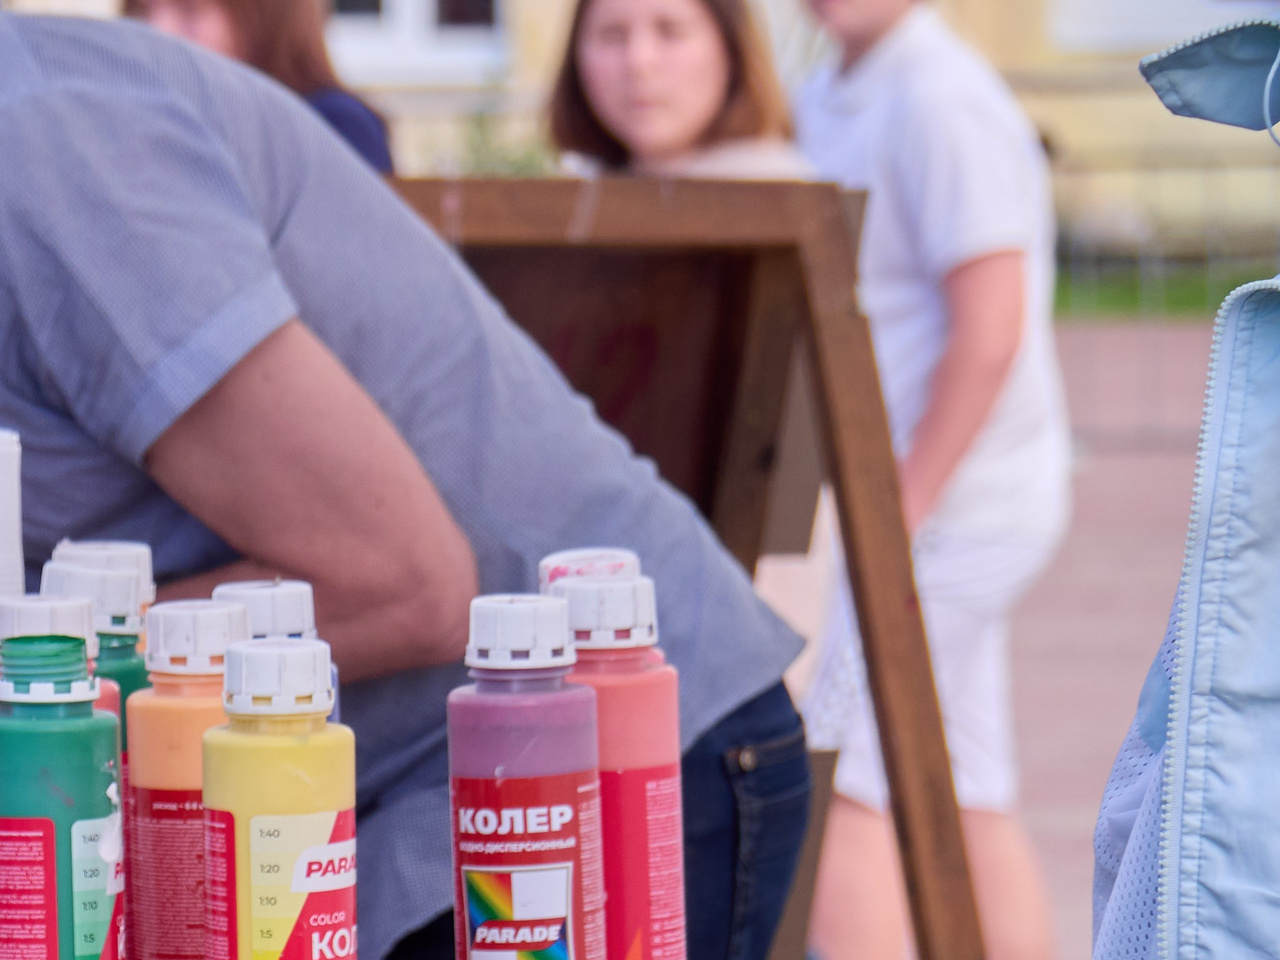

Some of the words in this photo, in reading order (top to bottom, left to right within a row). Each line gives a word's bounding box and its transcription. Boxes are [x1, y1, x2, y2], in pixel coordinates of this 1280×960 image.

[459, 805, 574, 835] КОЛЕР
[259, 829, 281, 838] 1:40
[260, 864, 280, 874] 1:20
[259, 897, 277, 906] 1:10
[309, 911, 346, 926] COLOR
[475, 925, 562, 944] PARADE
